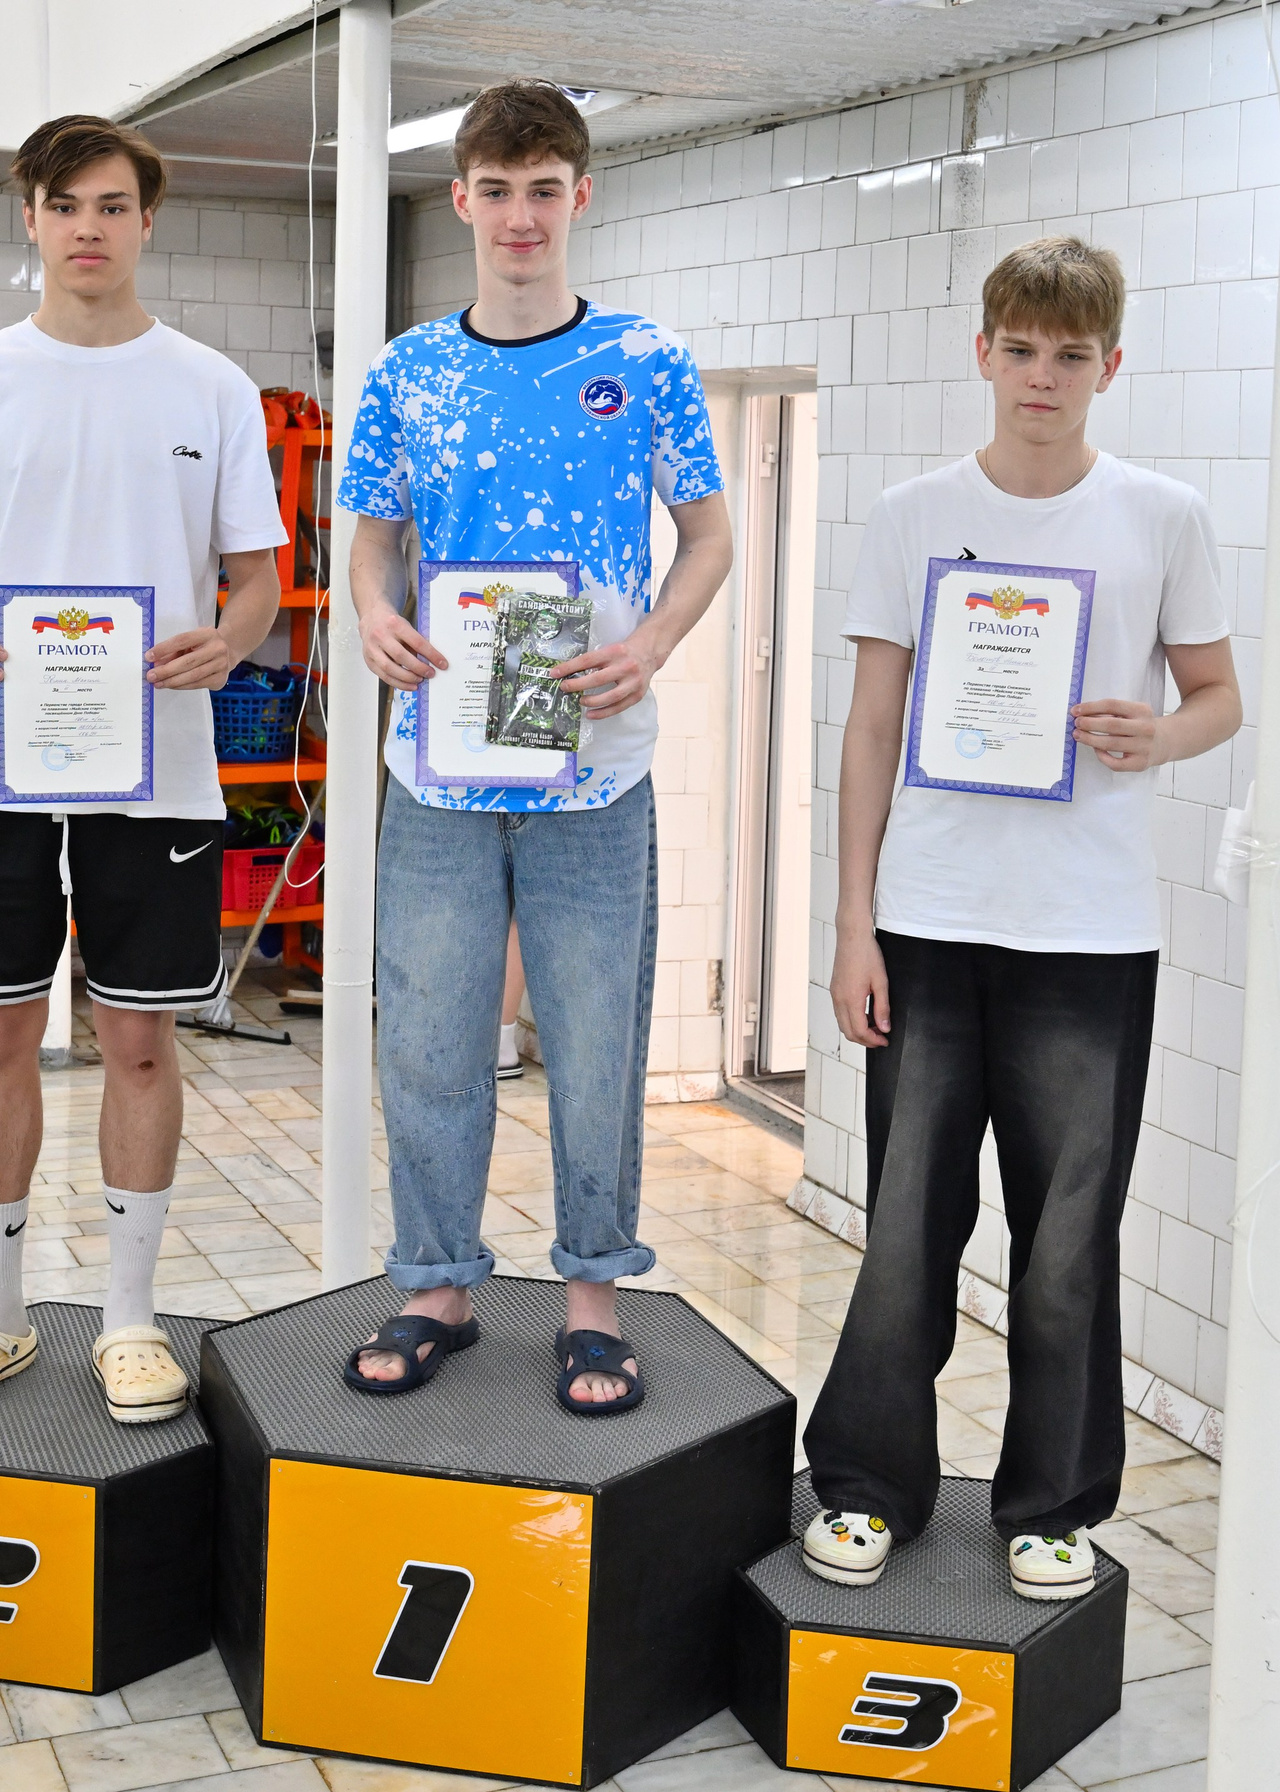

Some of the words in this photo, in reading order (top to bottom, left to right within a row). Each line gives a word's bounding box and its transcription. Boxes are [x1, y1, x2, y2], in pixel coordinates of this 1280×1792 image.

[968, 621, 1040, 638] ГРАМОТА
[38, 644, 108, 656] ГРАМОТА
[972, 643, 1031, 654] НАГРАЖДАЕТСЯ
[372, 1559, 475, 1685] 1
[838, 1671, 962, 1752] 3
